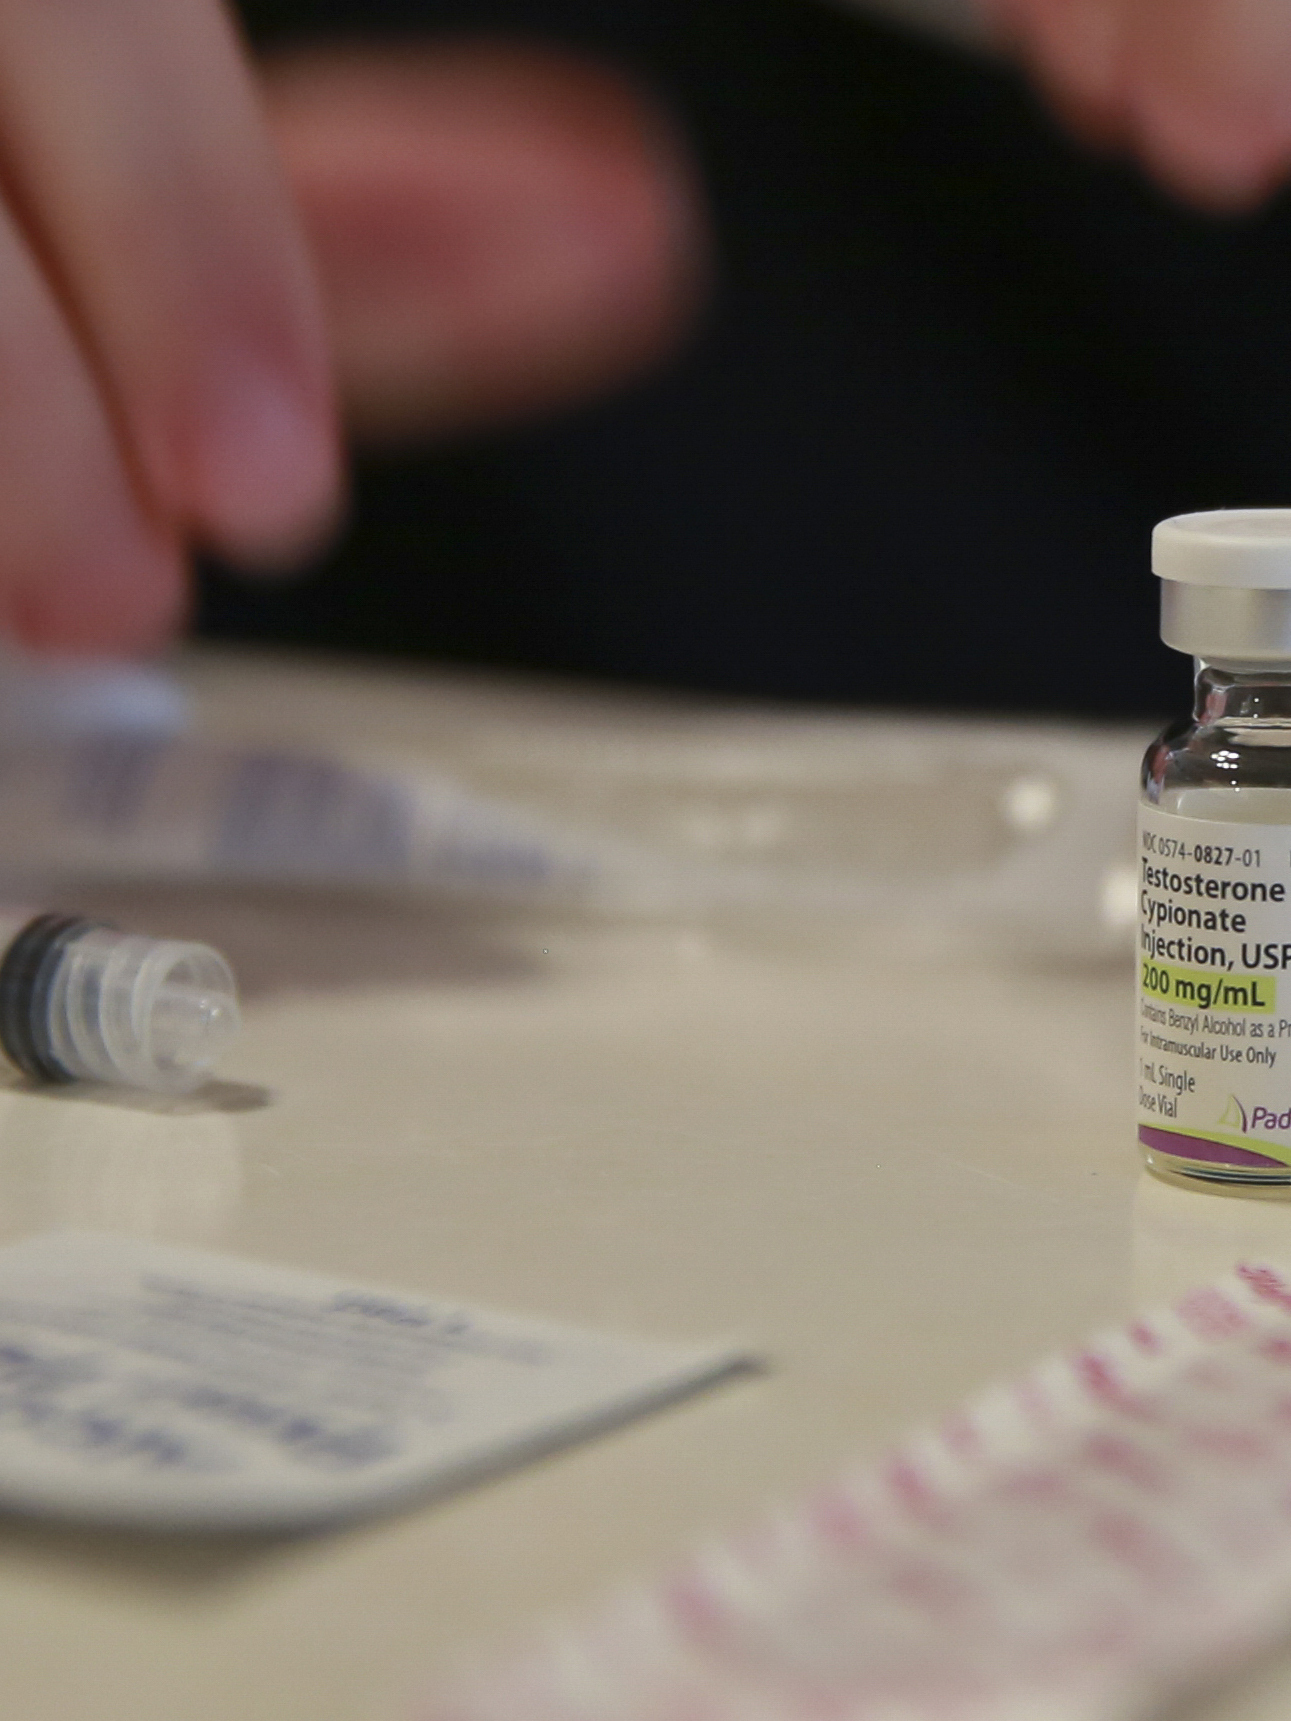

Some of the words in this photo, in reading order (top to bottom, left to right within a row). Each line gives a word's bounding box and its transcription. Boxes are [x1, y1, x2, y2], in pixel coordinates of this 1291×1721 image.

[1159, 837, 1261, 868] 0574-0827-01
[1141, 856, 1285, 902] Testosterone
[1140, 889, 1247, 933] Cypionate
[1141, 923, 1235, 972] Injection,
[1142, 962, 1170, 994] 200
[1175, 979, 1265, 1009] mg/mL
[1168, 1008, 1199, 1035] Benzyl
[1201, 1015, 1246, 1037] Alcohol
[1249, 1023, 1264, 1038] as
[1267, 1023, 1275, 1038] a
[1150, 1031, 1217, 1060] Intramuscular
[1220, 1044, 1243, 1062] Use
[1246, 1046, 1277, 1069] Only
[1158, 1065, 1196, 1096] Single
[1157, 1093, 1178, 1118] Vial
